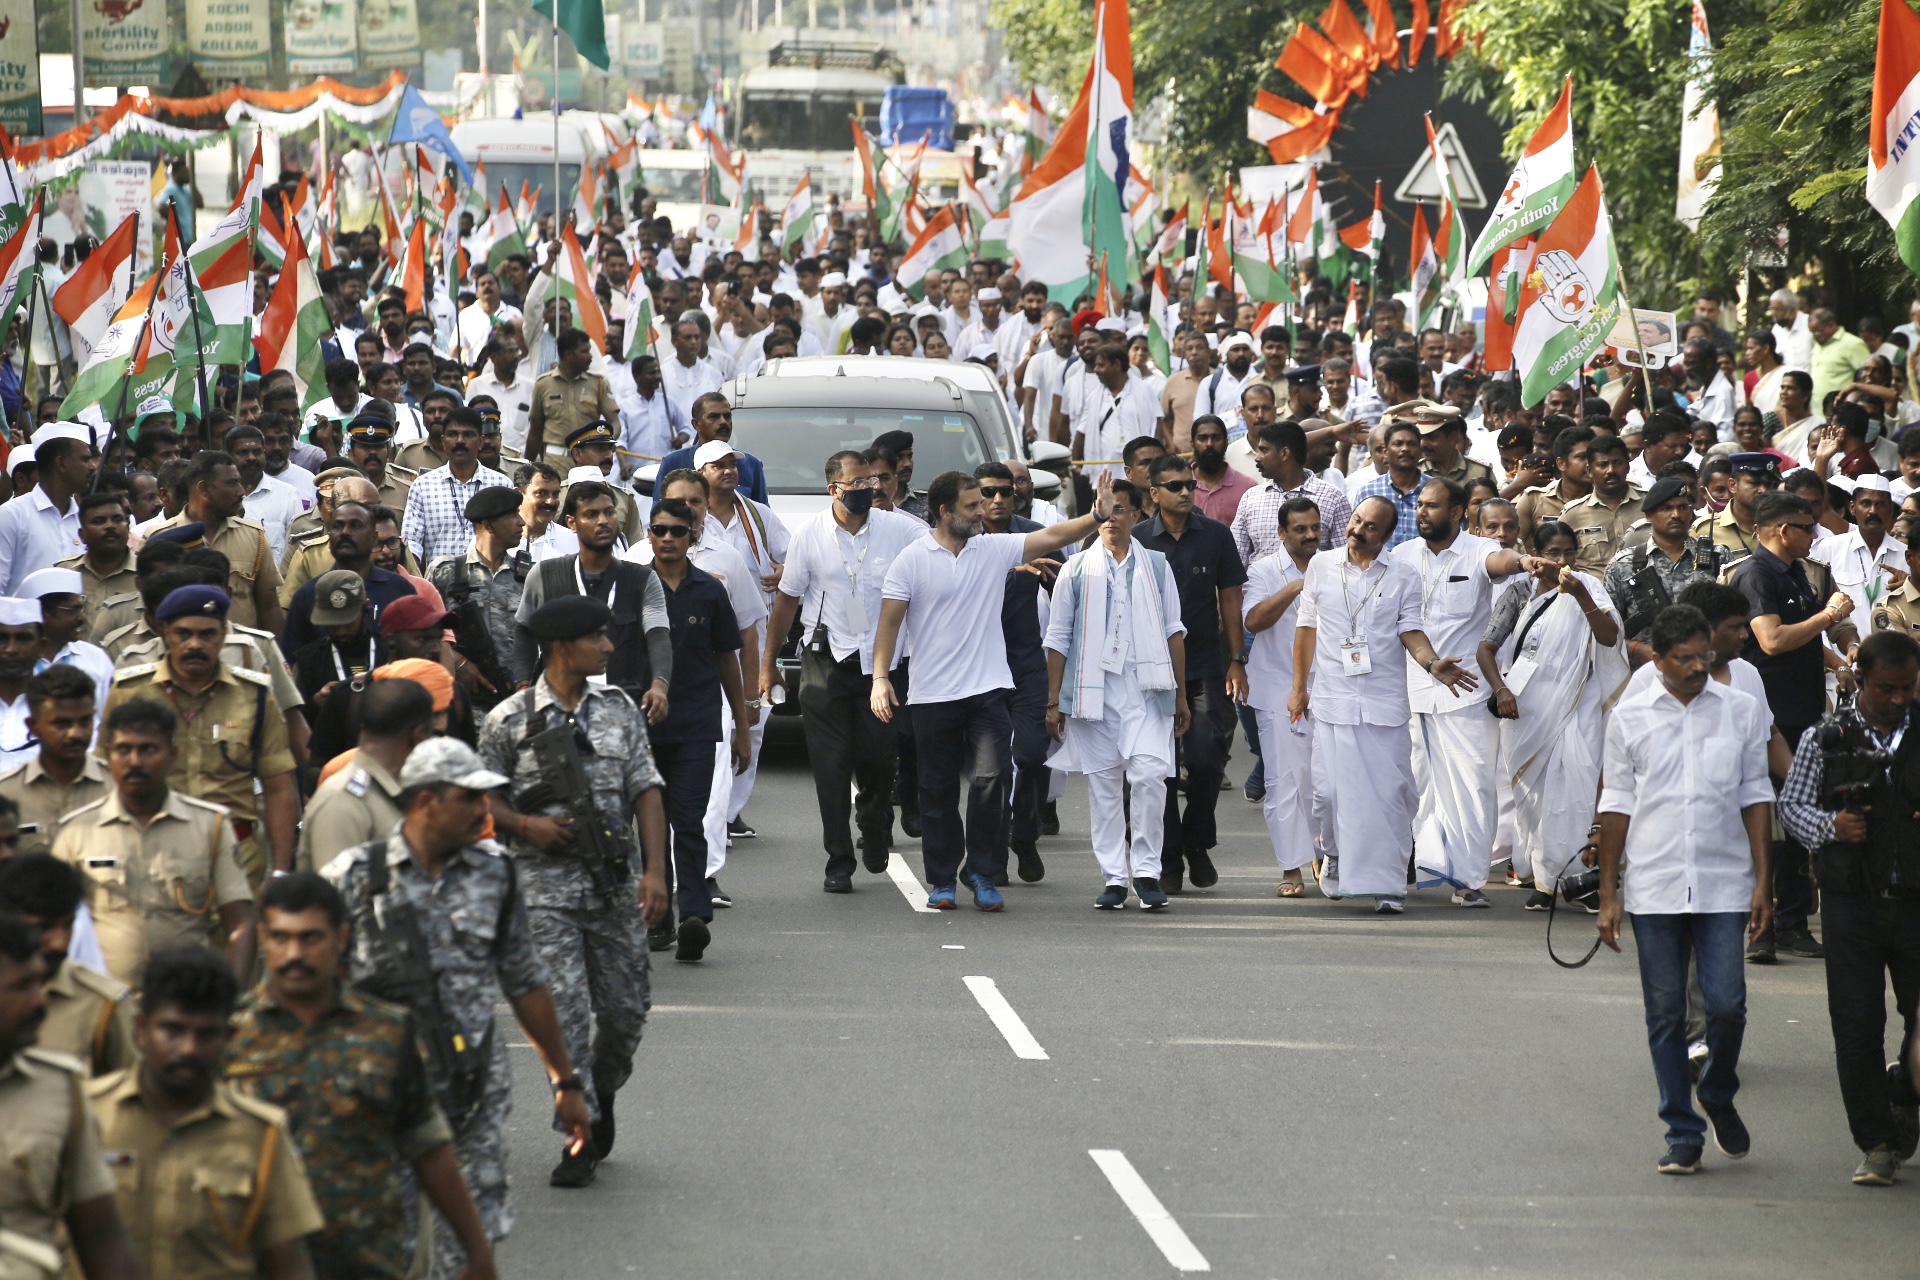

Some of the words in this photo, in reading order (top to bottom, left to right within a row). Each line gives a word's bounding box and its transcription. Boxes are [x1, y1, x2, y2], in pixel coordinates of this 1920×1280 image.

[207, 4, 249, 15] KOCHI
[85, 24, 159, 39] nfertility
[102, 40, 158, 50] Centre
[201, 40, 258, 51] KOLLAM
[0, 80, 26, 92] tre
[0, 106, 29, 119] Kochi
[1890, 109, 1920, 166] INTU
